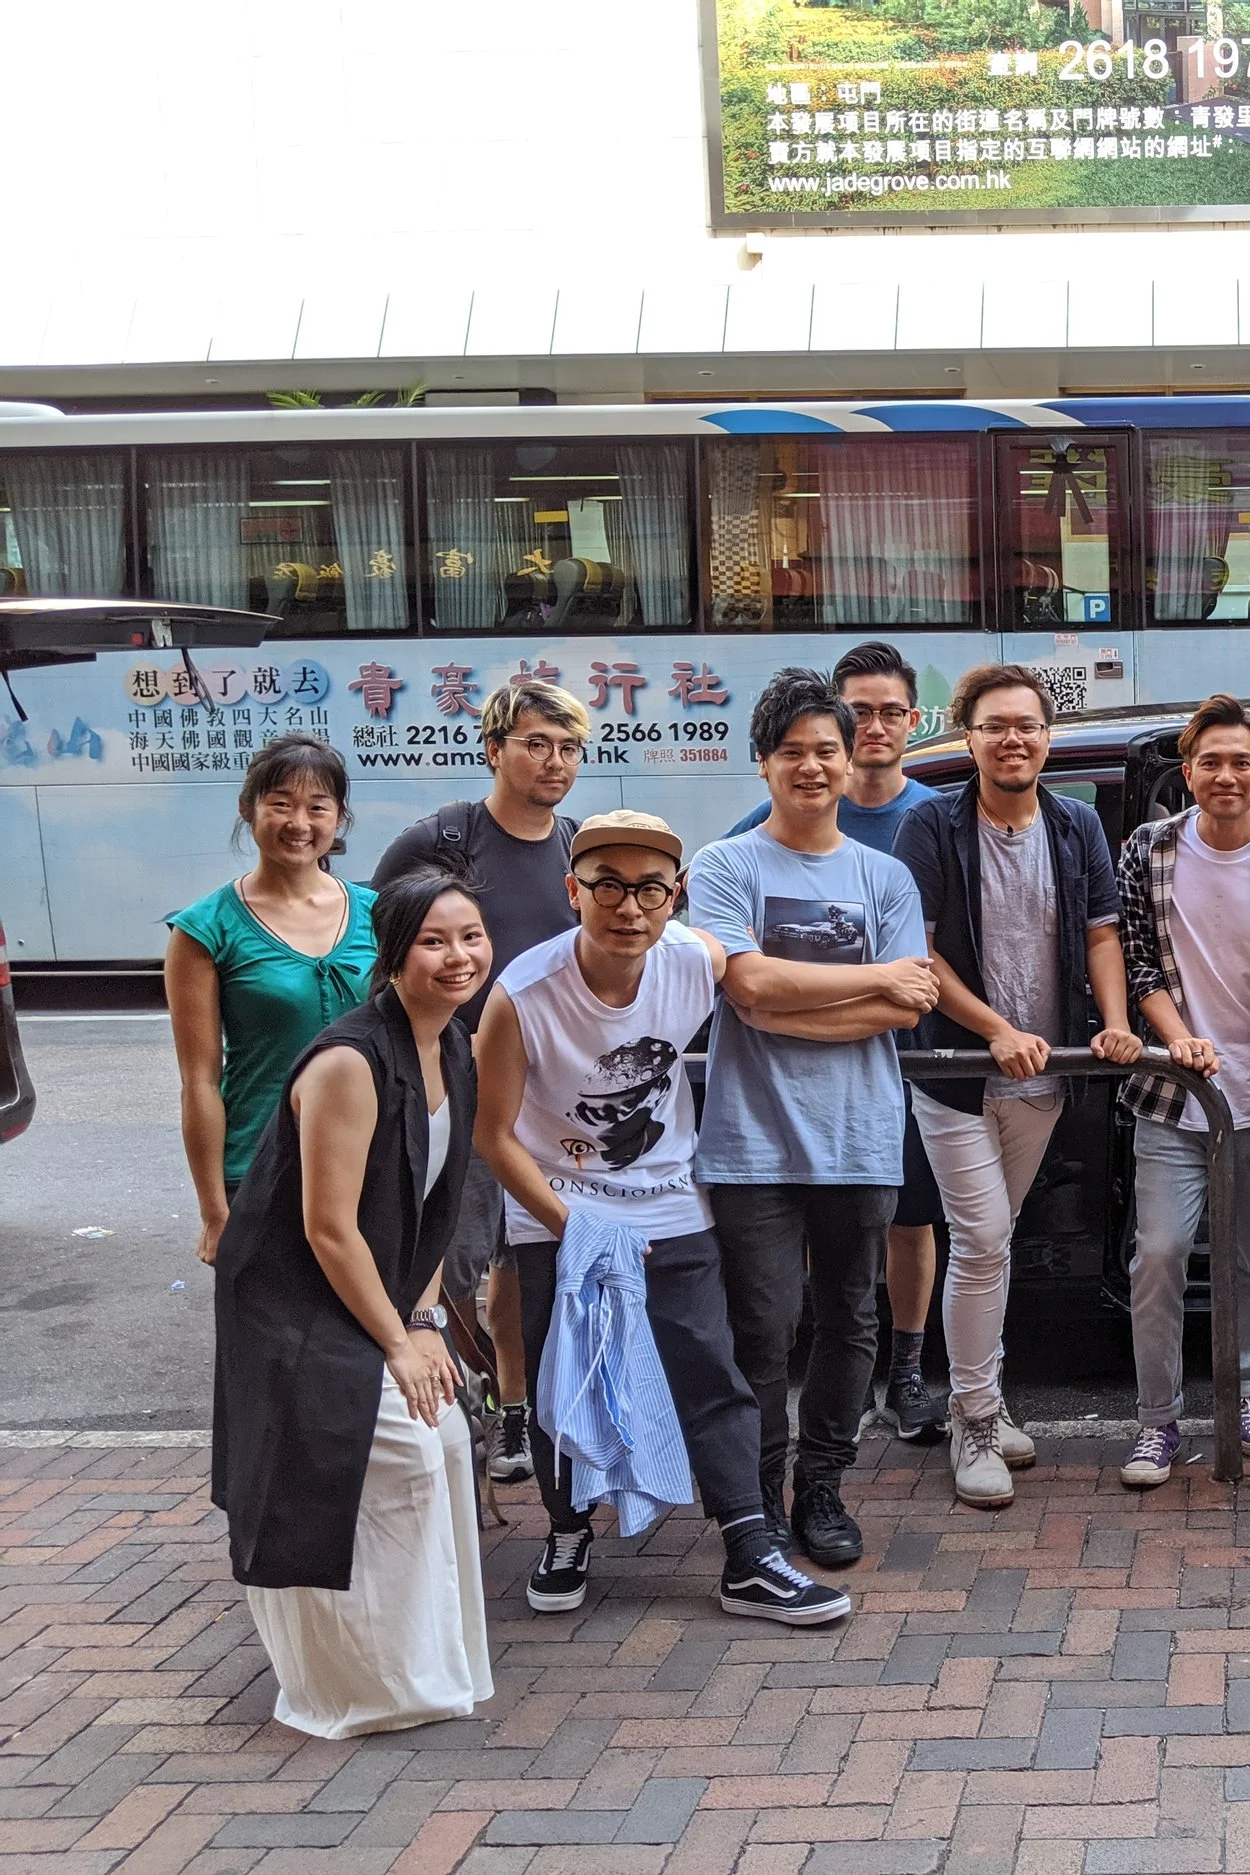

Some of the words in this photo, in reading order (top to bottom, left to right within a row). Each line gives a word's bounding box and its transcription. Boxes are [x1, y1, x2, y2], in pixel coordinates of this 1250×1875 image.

[1059, 39, 1169, 81] 2618
[768, 170, 1011, 196] www.jadegrove.com.hk
[128, 706, 328, 730] 中國佛教四大名山
[353, 724, 399, 748] 總社
[406, 725, 468, 745] 2216
[601, 722, 662, 743] 2566
[668, 721, 729, 743] 1989
[132, 751, 256, 773] 中國國家級重
[643, 749, 676, 765] 牌照
[680, 748, 728, 762] 351884
[549, 1170, 697, 1198] ONSCIOUSN
